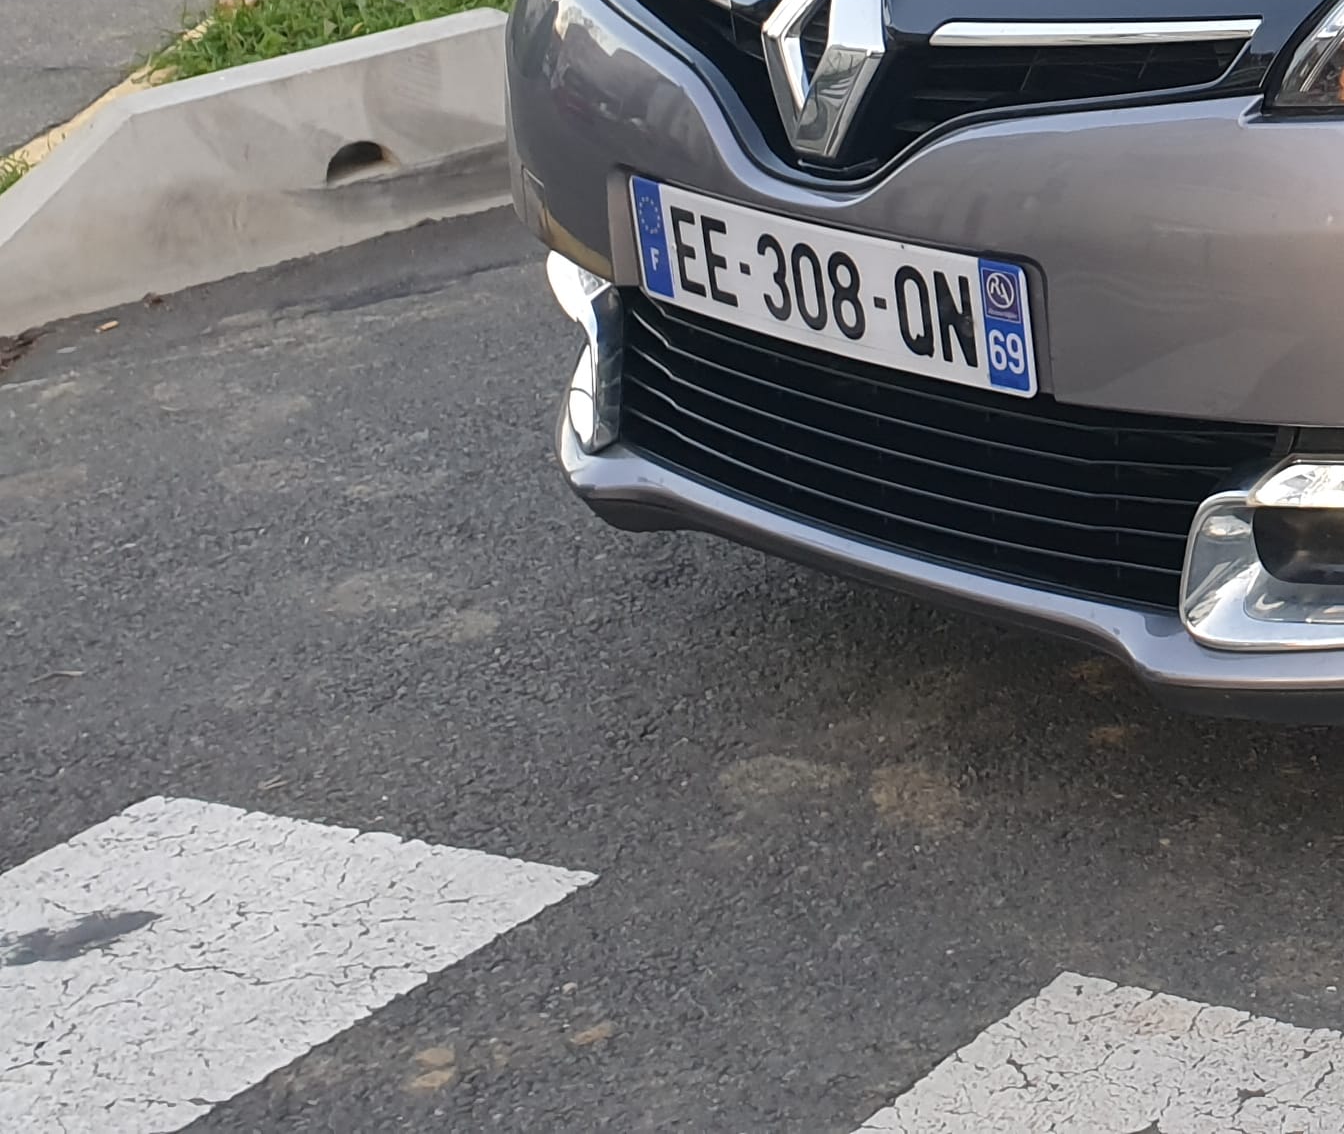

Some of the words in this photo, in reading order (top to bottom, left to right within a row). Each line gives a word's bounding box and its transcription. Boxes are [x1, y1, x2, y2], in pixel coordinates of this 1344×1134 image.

[650, 247, 659, 271] F
[670, 206, 978, 367] EE-308-QN
[989, 329, 1025, 374] 69
